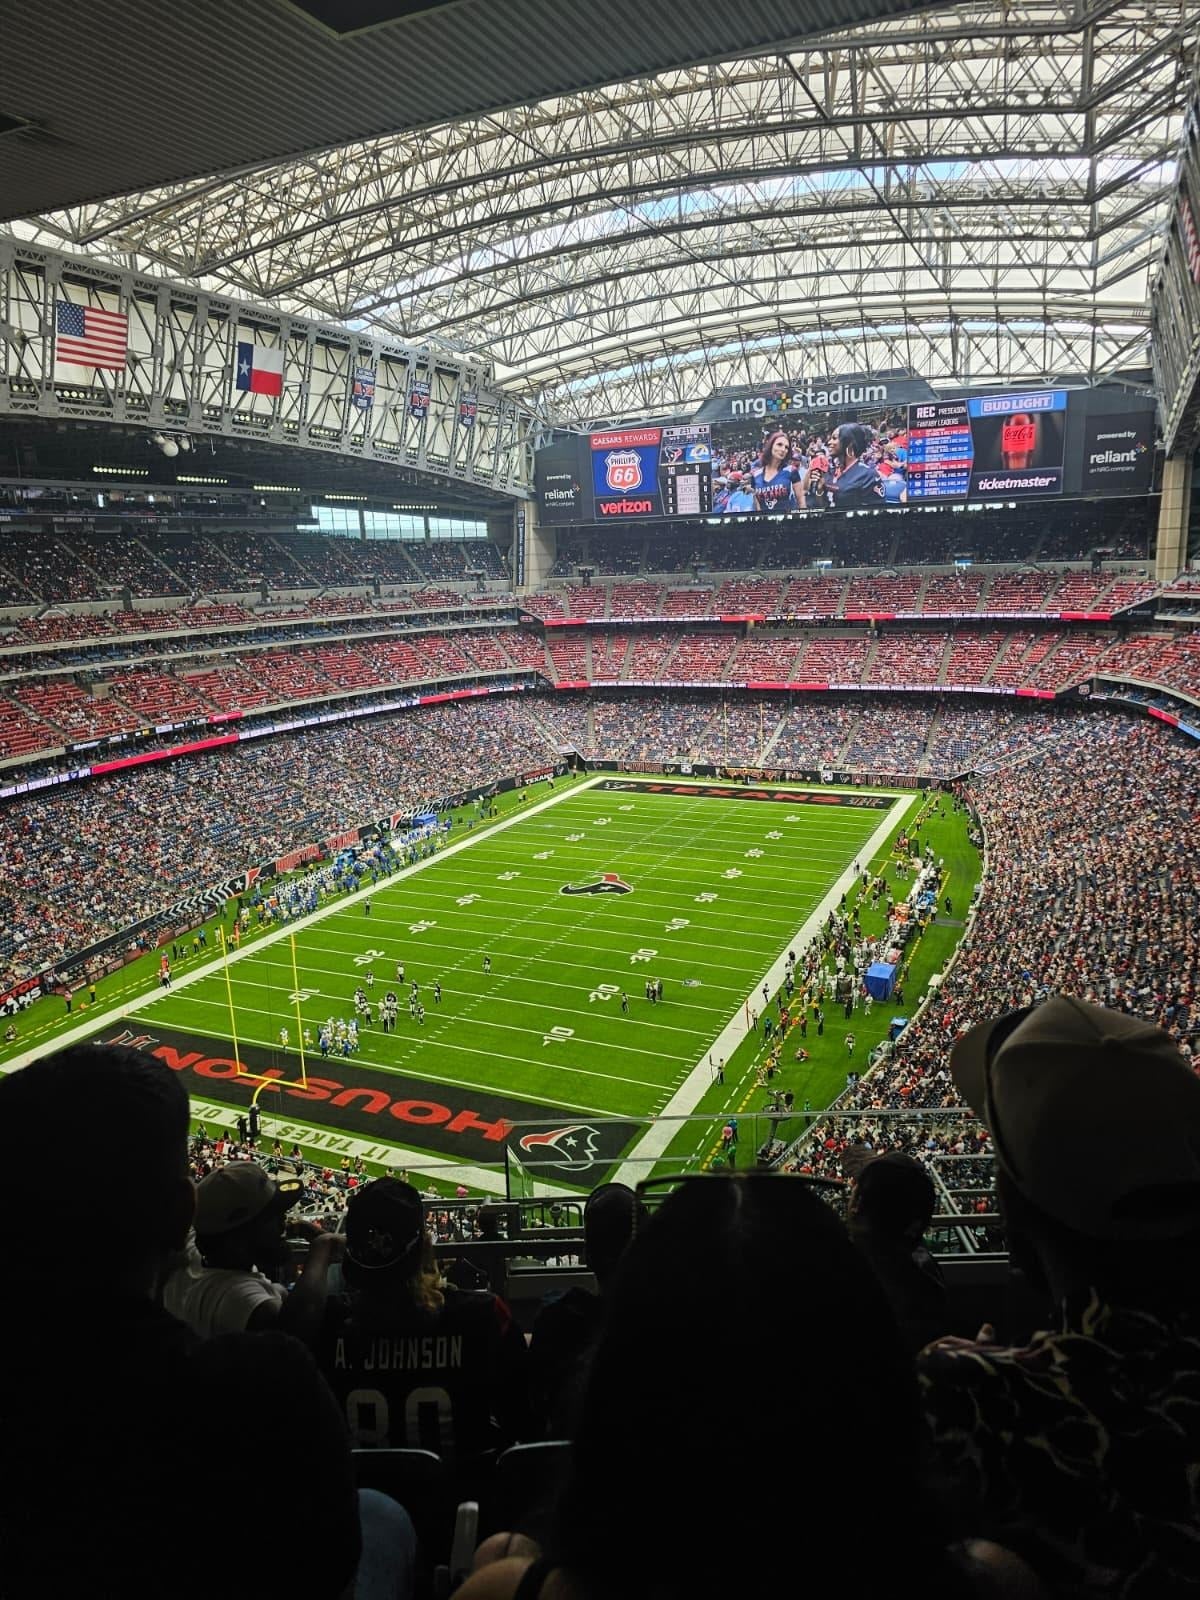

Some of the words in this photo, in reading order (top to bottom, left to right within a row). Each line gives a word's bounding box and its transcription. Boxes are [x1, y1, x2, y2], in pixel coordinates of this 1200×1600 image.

[731, 398, 767, 417] nrg
[793, 384, 888, 409] stadium
[983, 399, 1010, 412] BUD
[1011, 396, 1051, 409] LIGHT
[916, 406, 936, 419] REC
[592, 436, 623, 446] CAESARS
[624, 433, 658, 443] REWARDS
[1097, 432, 1127, 440] powered
[1127, 430, 1137, 439] by
[610, 456, 636, 465] PHILLIPS
[1090, 449, 1137, 464] reliant
[613, 467, 635, 483] 66
[978, 476, 1051, 491] ticketmaster
[544, 488, 575, 500] reliant
[600, 498, 652, 514] verizon
[645, 783, 842, 805] TEXANS
[664, 918, 690, 931] 40
[353, 949, 385, 963] 20
[631, 948, 658, 962] 30
[590, 983, 620, 1000] 20
[543, 1026, 575, 1043] 10
[151, 1045, 515, 1142] HOUSTON
[276, 1125, 355, 1153] TAKES
[363, 1148, 390, 1161] IT
[334, 1336, 353, 1370] A.
[363, 1335, 465, 1371] JOHNSON
